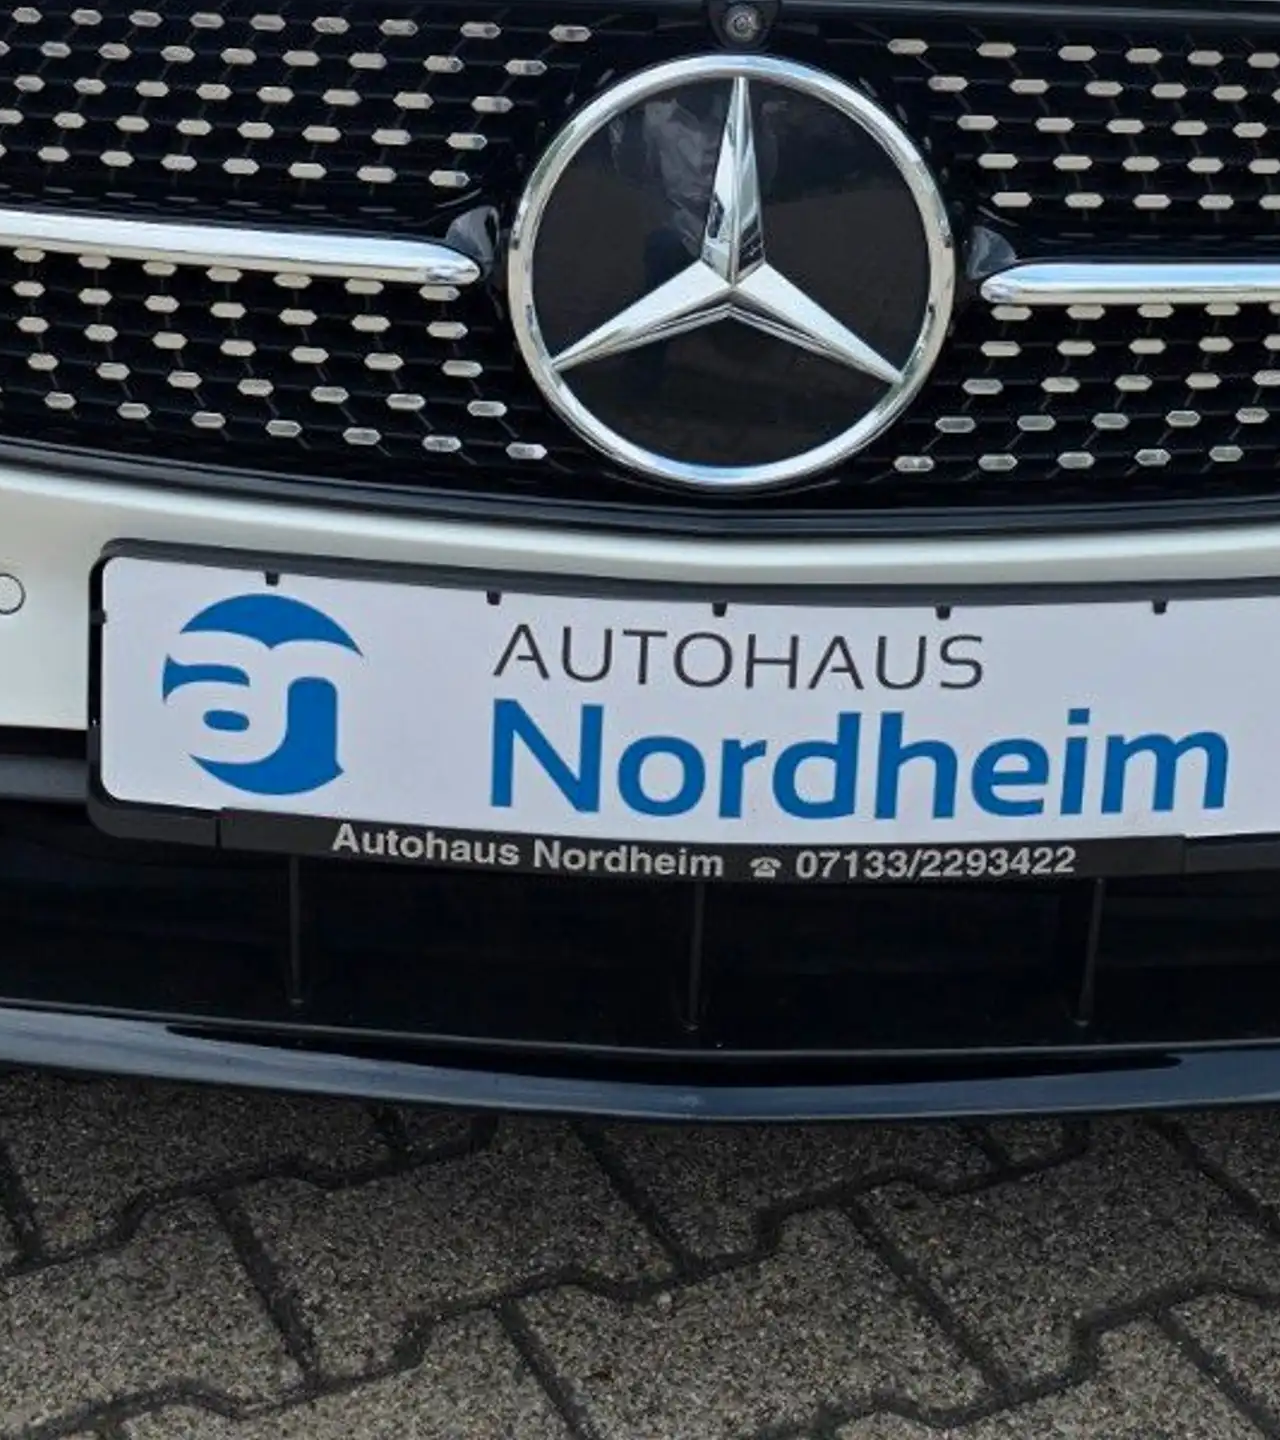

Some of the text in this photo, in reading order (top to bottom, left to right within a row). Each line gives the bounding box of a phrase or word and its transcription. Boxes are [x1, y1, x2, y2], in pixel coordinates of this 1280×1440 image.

[493, 623, 984, 690] AUTOHAUS
[490, 698, 1229, 820] Nordheim
[332, 823, 1077, 880] Autohaus Nordheim 07133/2293422
